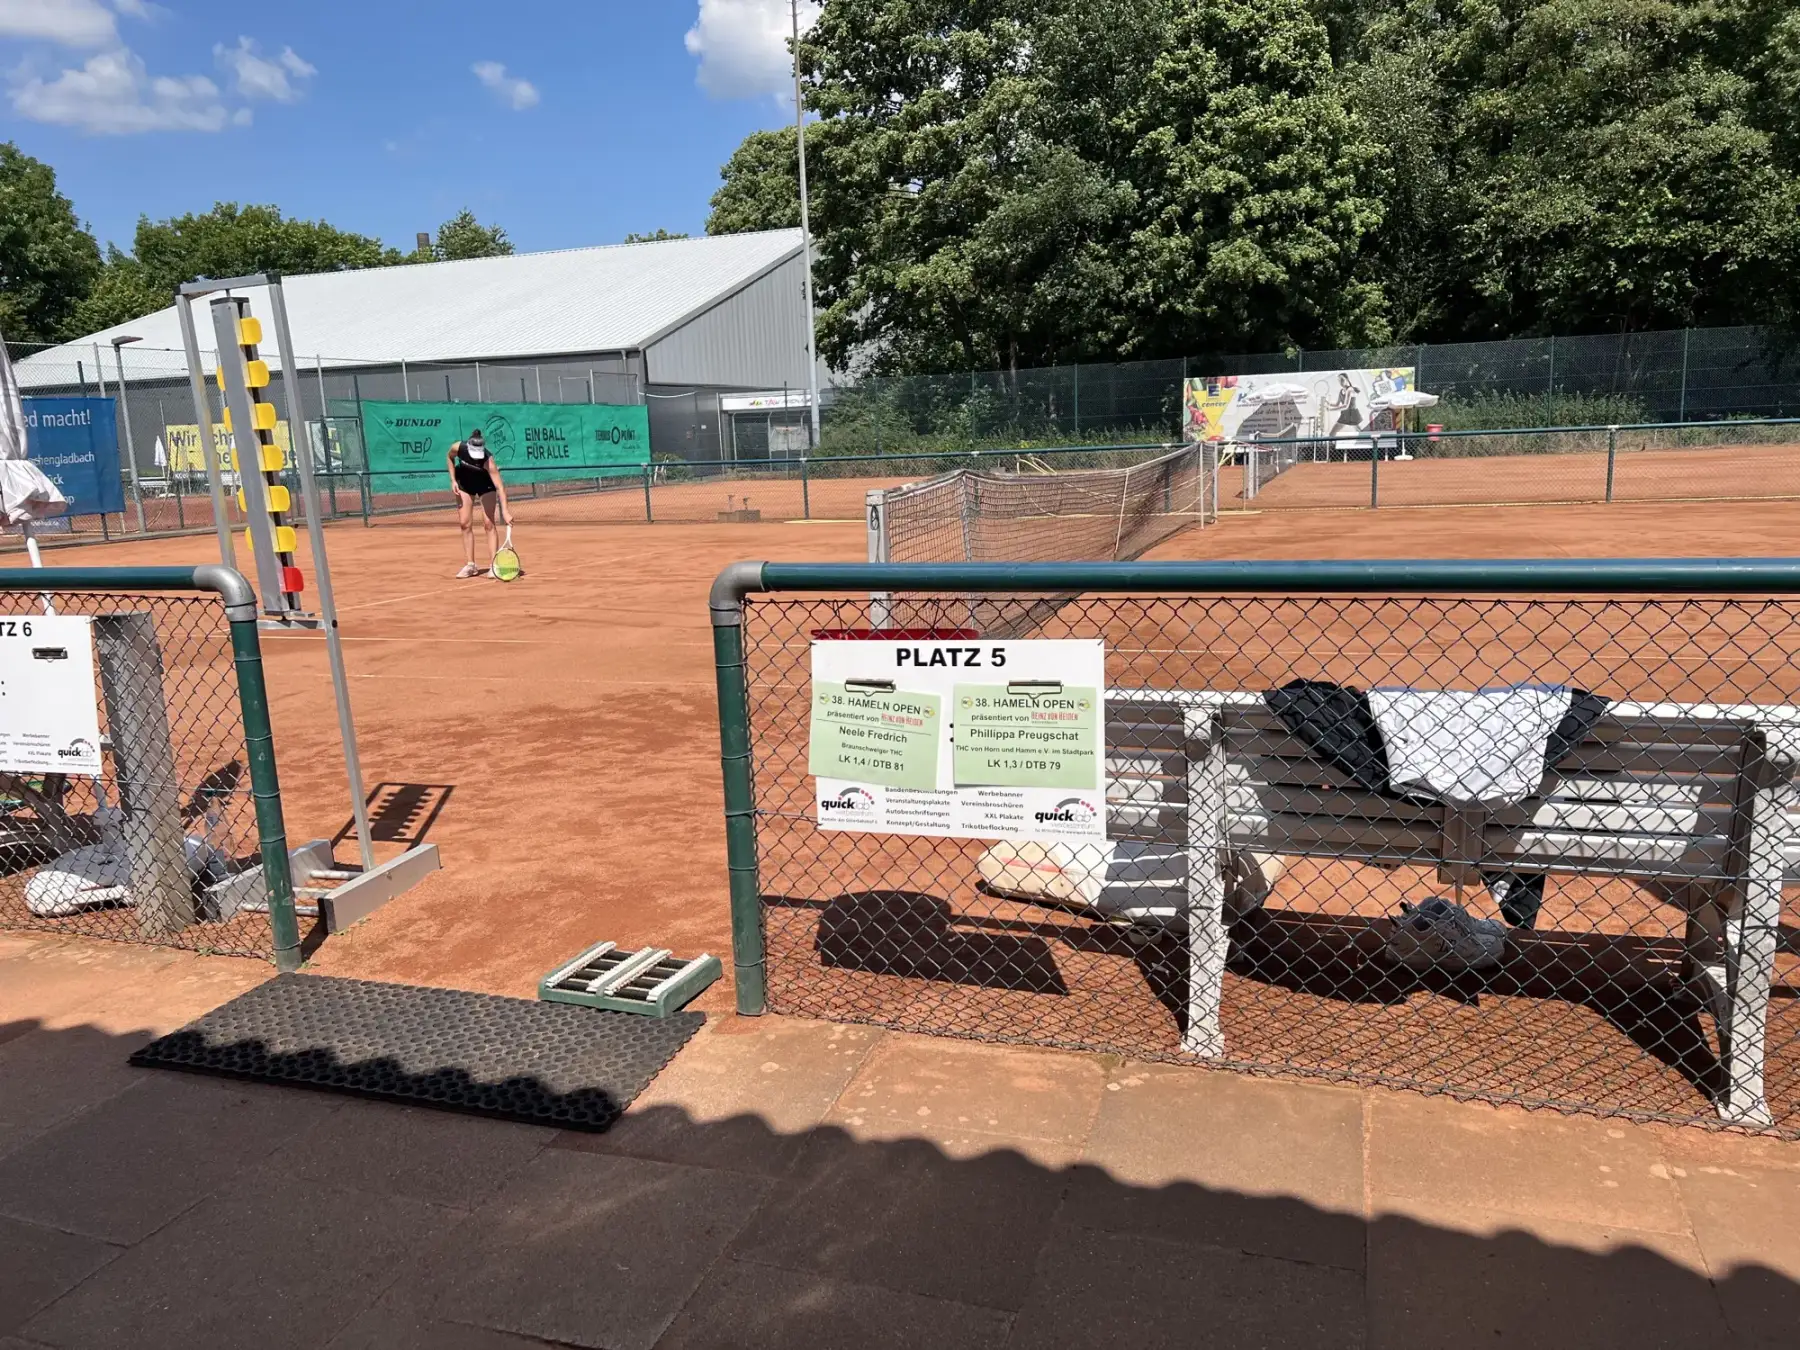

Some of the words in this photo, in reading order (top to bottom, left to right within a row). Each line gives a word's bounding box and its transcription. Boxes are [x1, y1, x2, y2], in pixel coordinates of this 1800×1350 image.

[43, 409, 91, 427] macht!
[395, 419, 442, 427] DUNLOP
[525, 428, 540, 441] EIN
[543, 427, 566, 441] BALL
[527, 442, 544, 460] FÜR
[547, 444, 570, 459] ALLE
[23, 621, 32, 637] 6
[896, 648, 981, 667] PLATZ
[991, 648, 1006, 667] 5
[832, 696, 845, 705] 38.
[848, 698, 890, 711] HAMELN
[893, 703, 921, 715] OPEN
[975, 698, 990, 707] 38.
[993, 699, 1040, 709] HAMELN
[1043, 700, 1075, 709] OPEN
[827, 710, 865, 721] präsentiert
[971, 713, 1013, 722] präsentiert
[839, 726, 865, 738] Neele
[868, 729, 908, 743] Fredrich
[970, 728, 1015, 740] Phillippa
[1018, 730, 1079, 742] Preugschat
[841, 742, 889, 755] Braunschweiger
[1062, 748, 1094, 756] Stadtpark
[839, 754, 851, 764] LK
[854, 757, 866, 766] 1,4
[873, 759, 892, 769] DTB
[894, 763, 904, 772] 81
[987, 759, 1001, 768] LK
[1004, 760, 1017, 770] 1,3
[1025, 760, 1047, 769] DTB
[1049, 761, 1061, 770] 79
[886, 797, 950, 806] Veranstaltungsplakate
[961, 800, 1024, 808] Vereinsbroschüren
[886, 809, 950, 817] Autobeschriftungen
[886, 820, 950, 829] Konzept/Gestaltung
